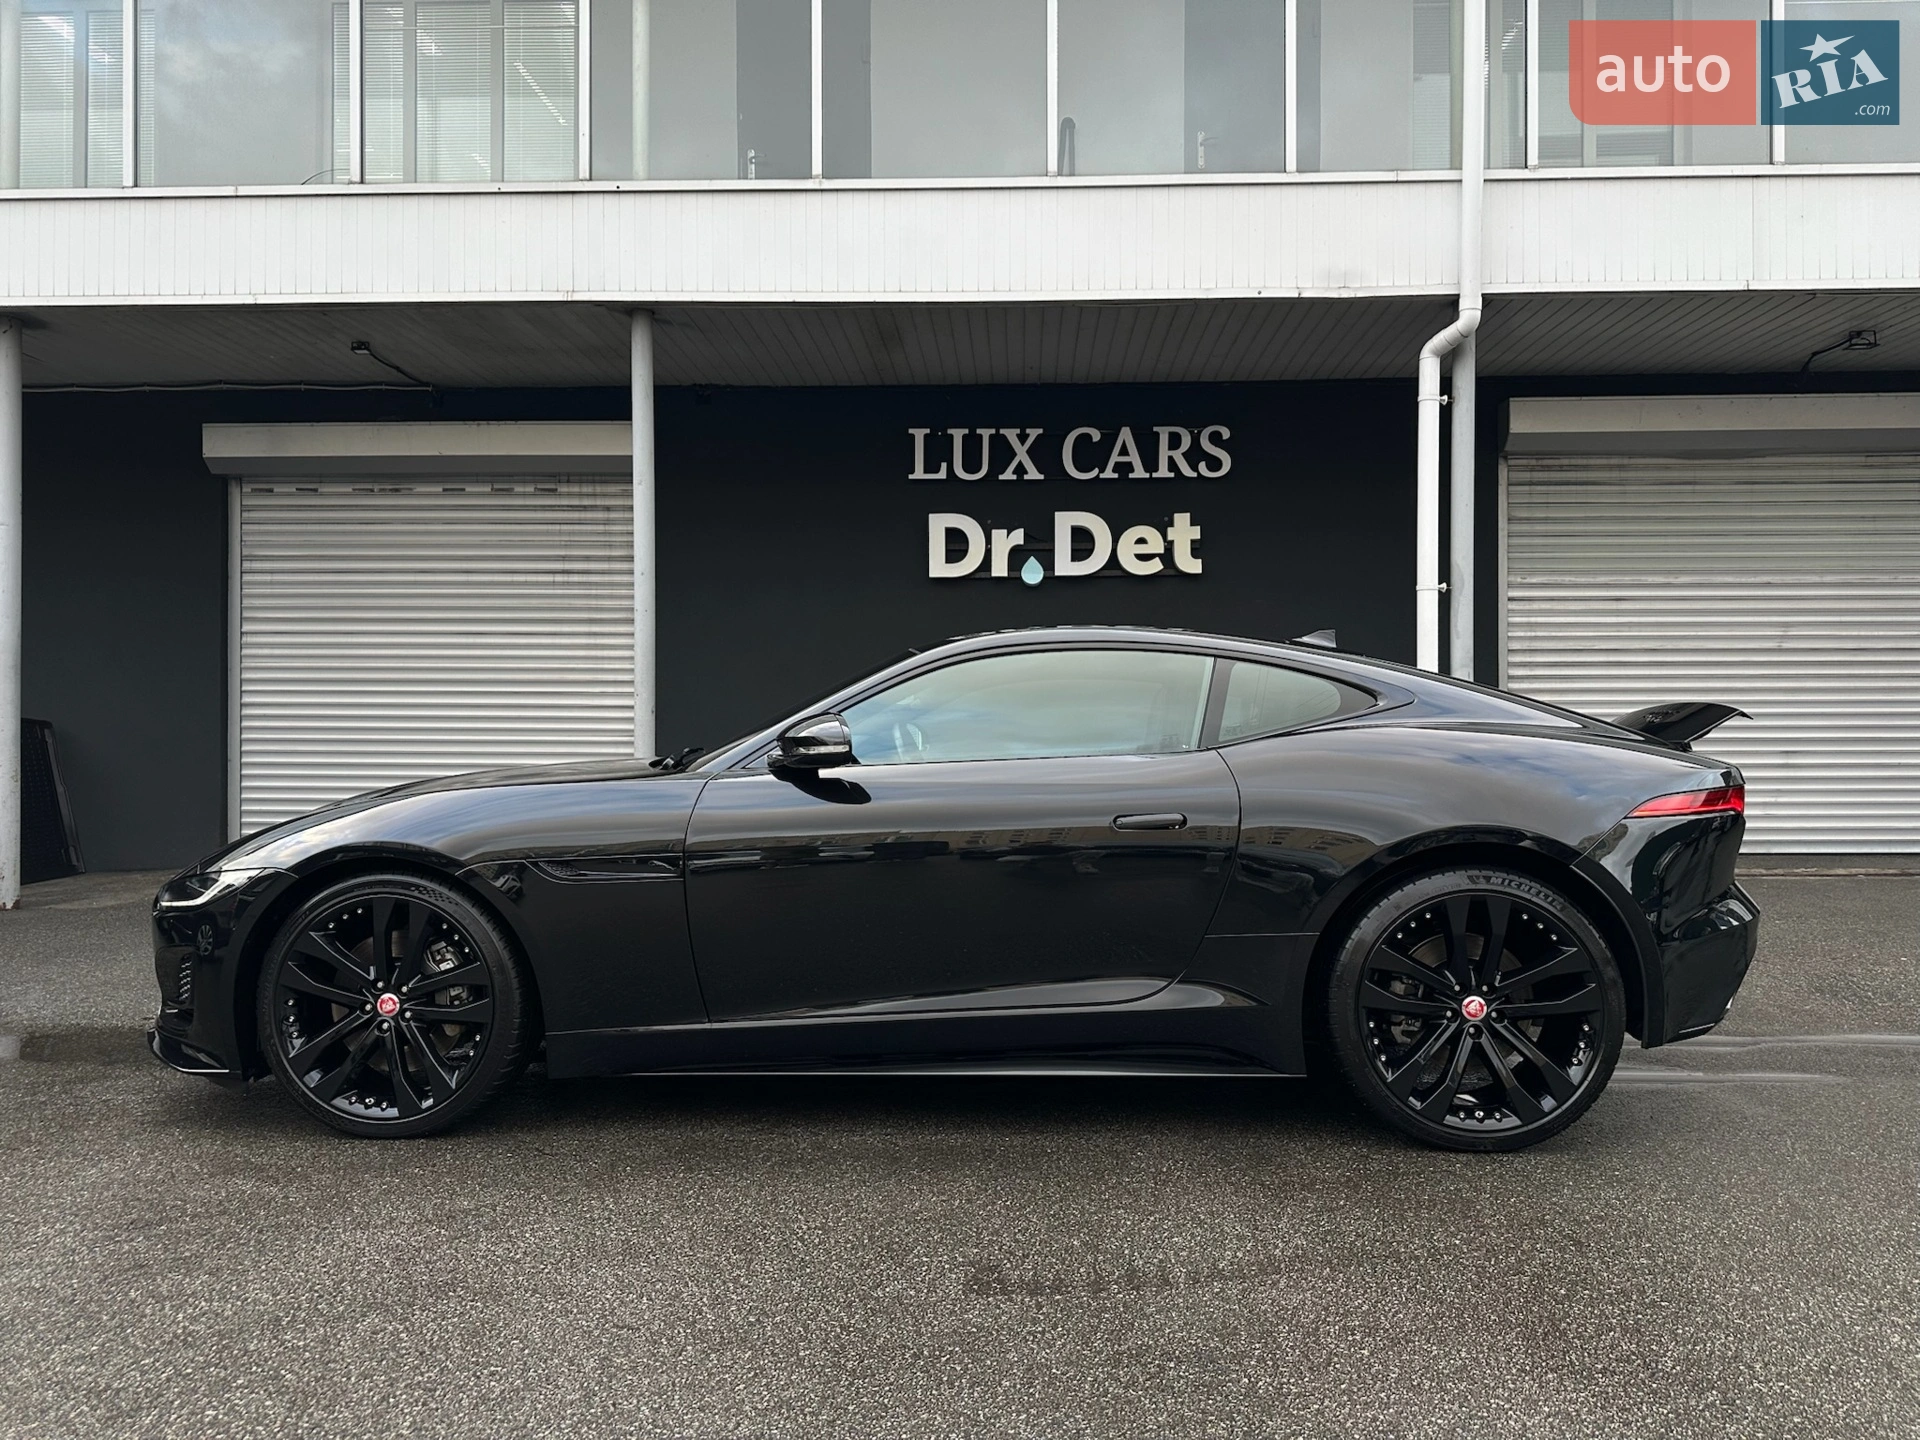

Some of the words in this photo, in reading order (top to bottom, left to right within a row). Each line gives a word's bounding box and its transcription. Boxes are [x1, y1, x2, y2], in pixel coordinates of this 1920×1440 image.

[908, 428, 1045, 481] LUX
[1062, 425, 1232, 479] CARS
[1054, 511, 1203, 577] Det
[1489, 875, 1564, 911] MICHELIN
